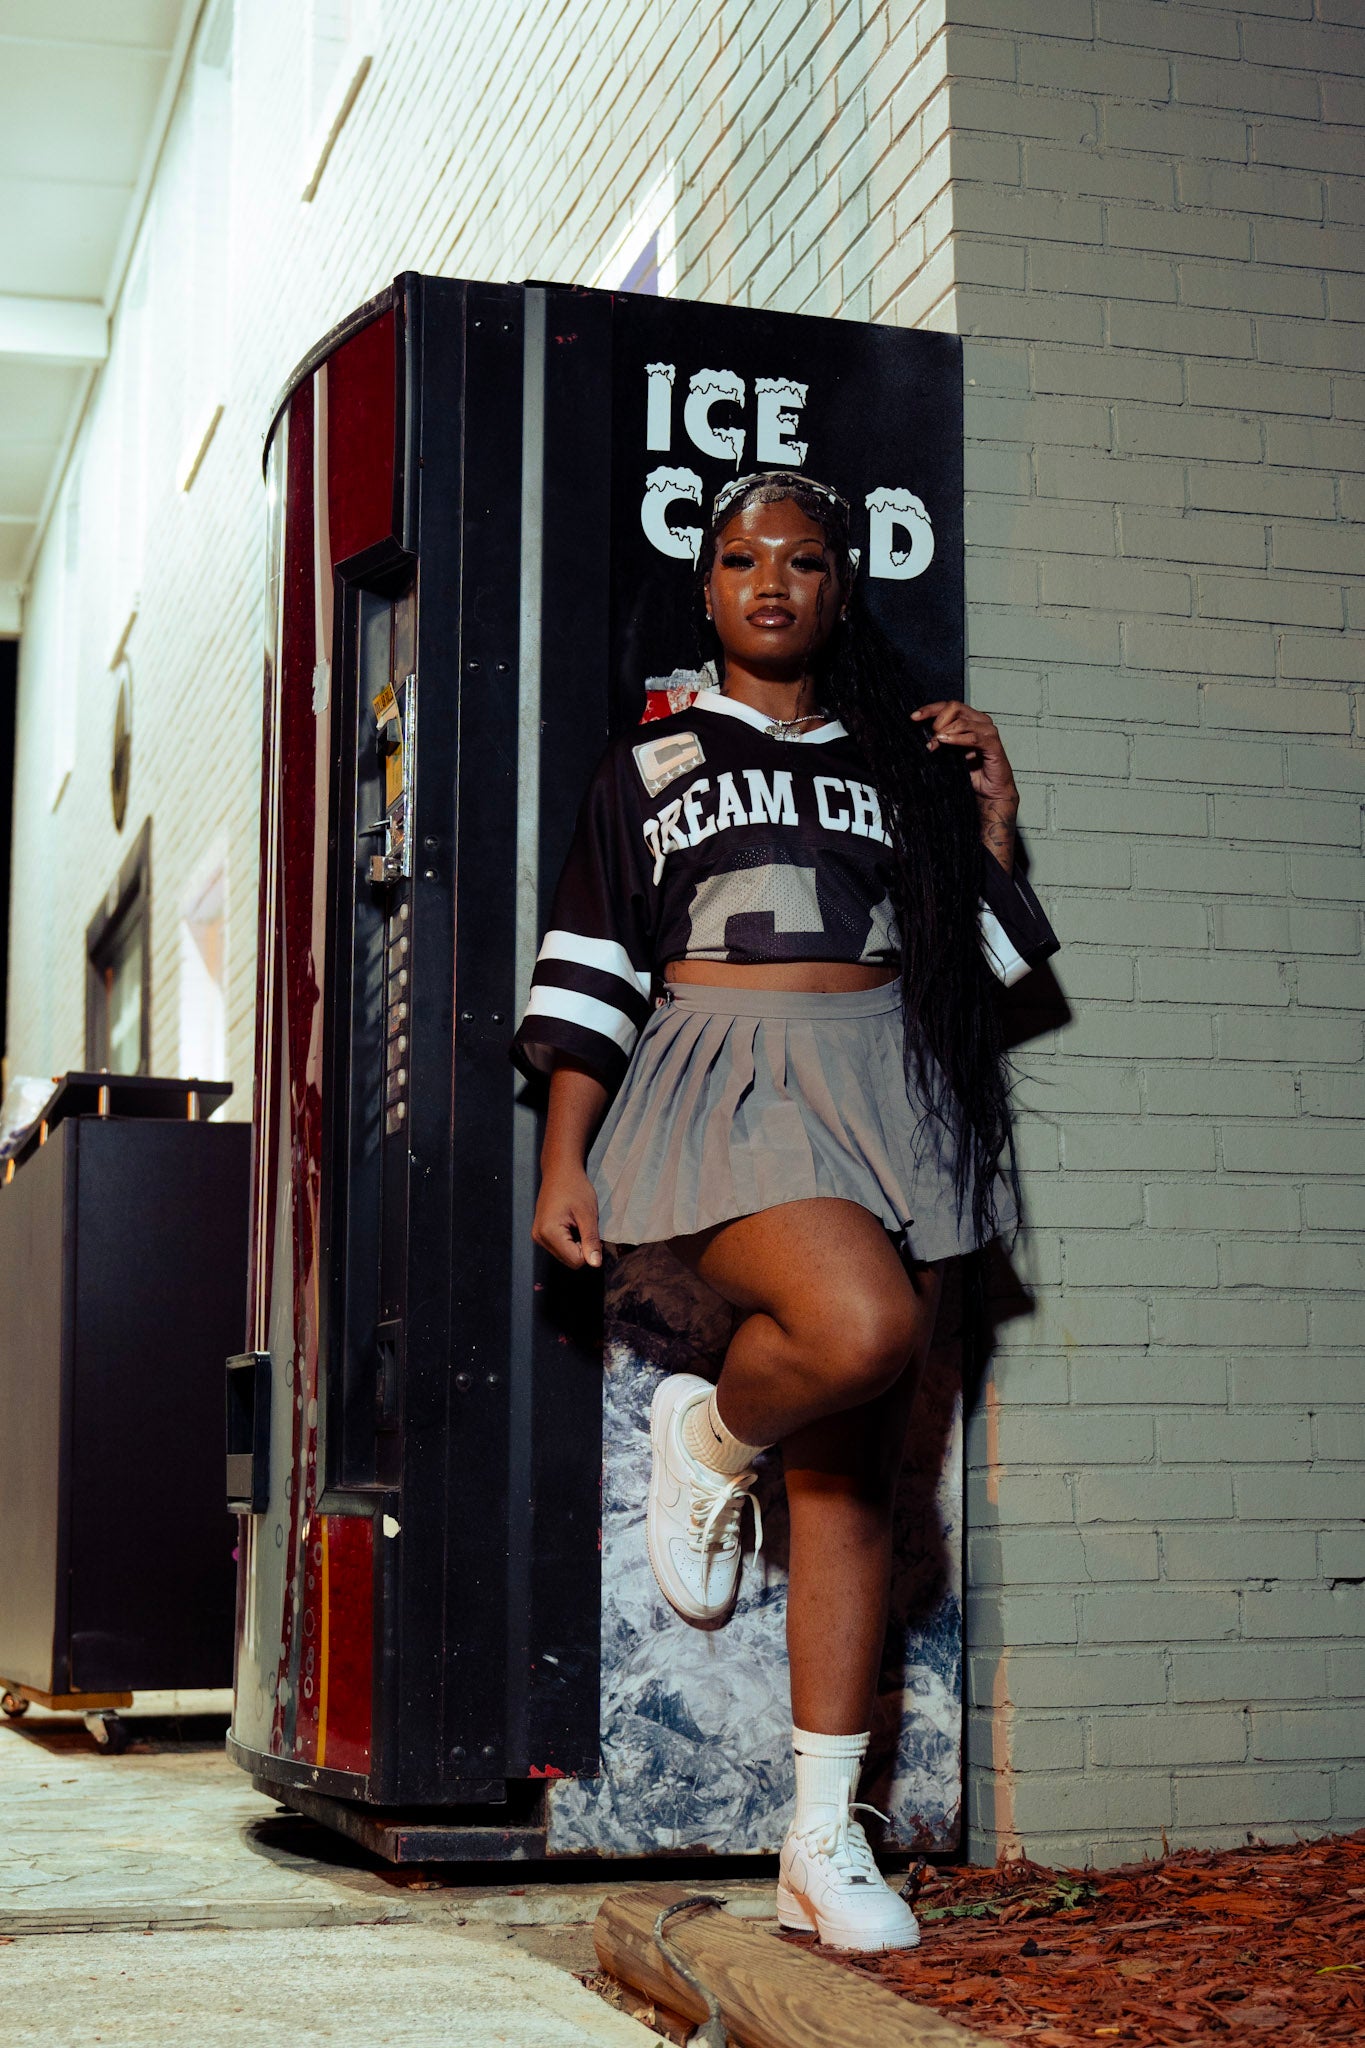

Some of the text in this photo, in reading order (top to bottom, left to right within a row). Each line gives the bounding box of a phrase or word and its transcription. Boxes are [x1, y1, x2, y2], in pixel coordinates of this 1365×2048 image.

[644, 361, 809, 472] ICE
[640, 466, 935, 581] CD
[813, 776, 893, 849] CH
